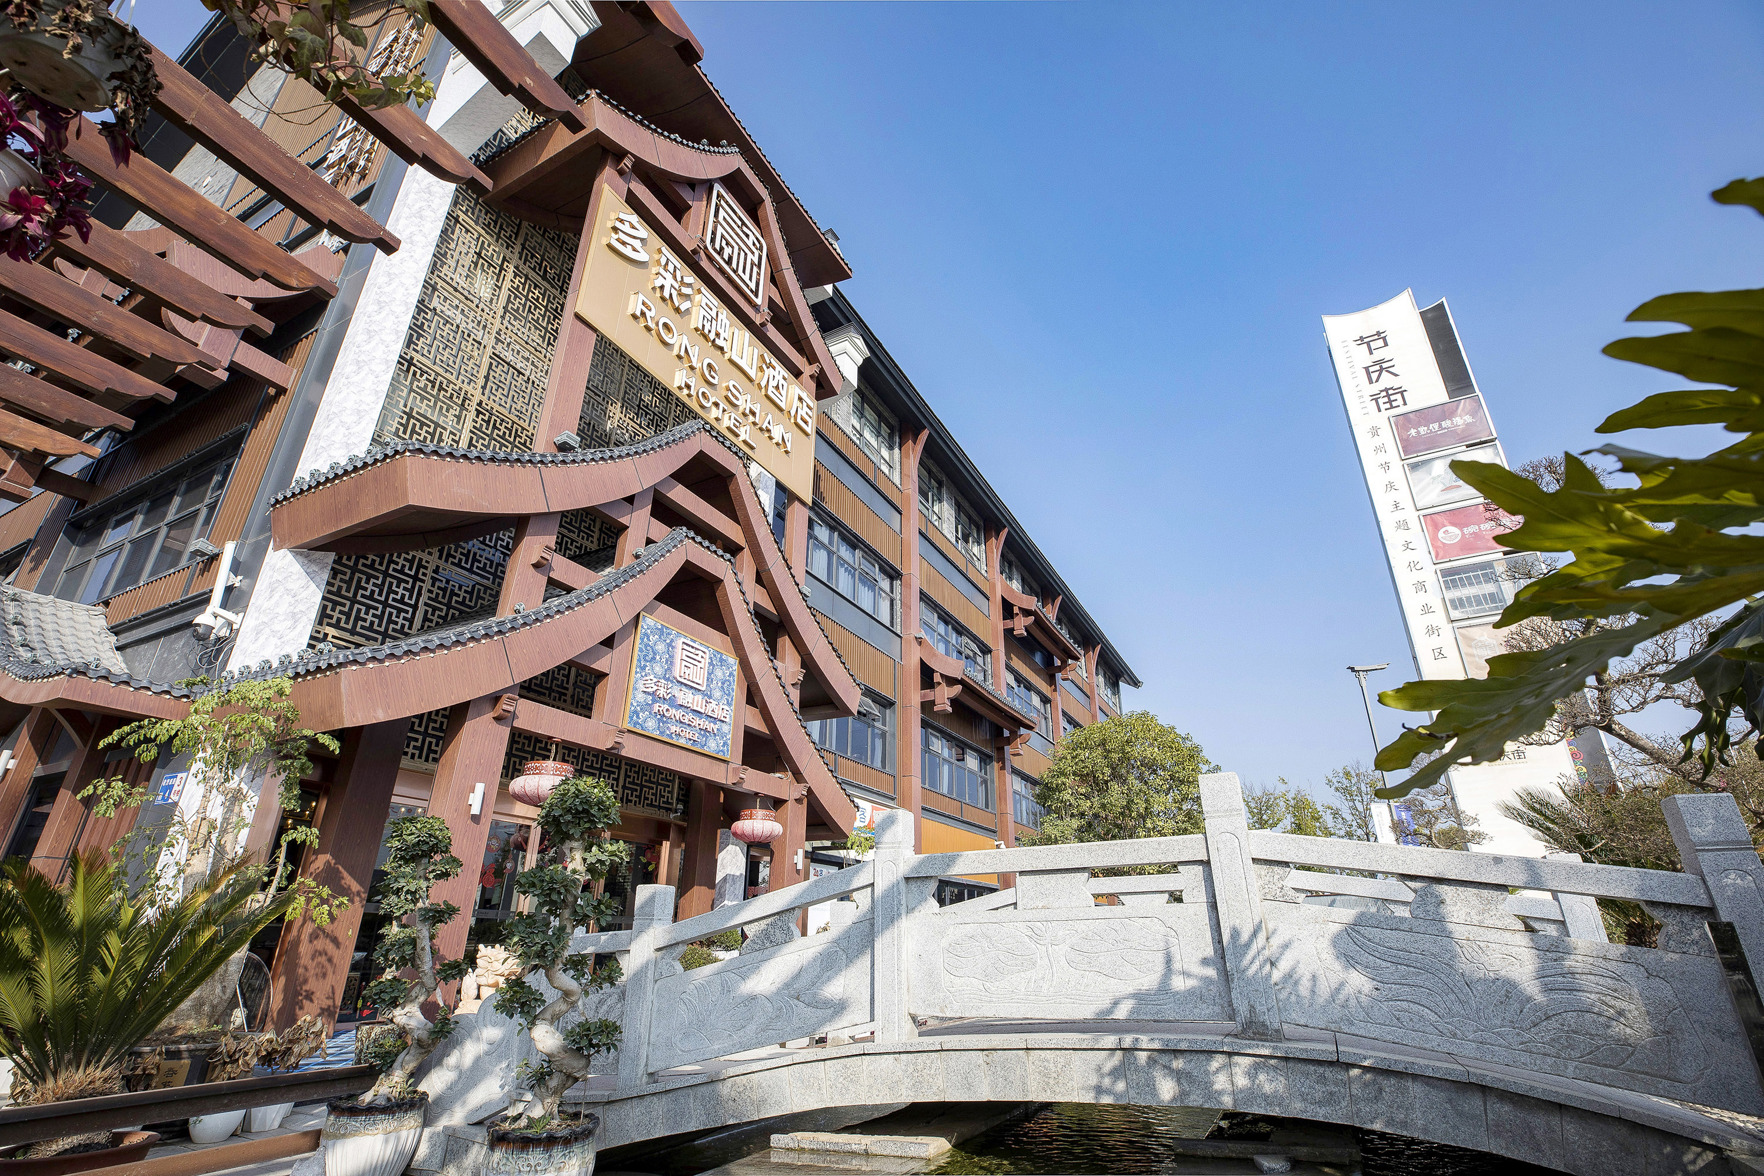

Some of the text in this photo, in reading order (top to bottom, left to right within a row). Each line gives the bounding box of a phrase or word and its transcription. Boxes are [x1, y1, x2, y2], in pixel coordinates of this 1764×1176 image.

[605, 211, 814, 436] 多彩融山酒店
[629, 291, 792, 454] RONG SHAN
[1353, 330, 1408, 413] 节庆街
[674, 367, 756, 449] HOTEL
[1367, 426, 1447, 661] 贵州节庆主题文化商业街区
[671, 725, 700, 742] HOTEL
